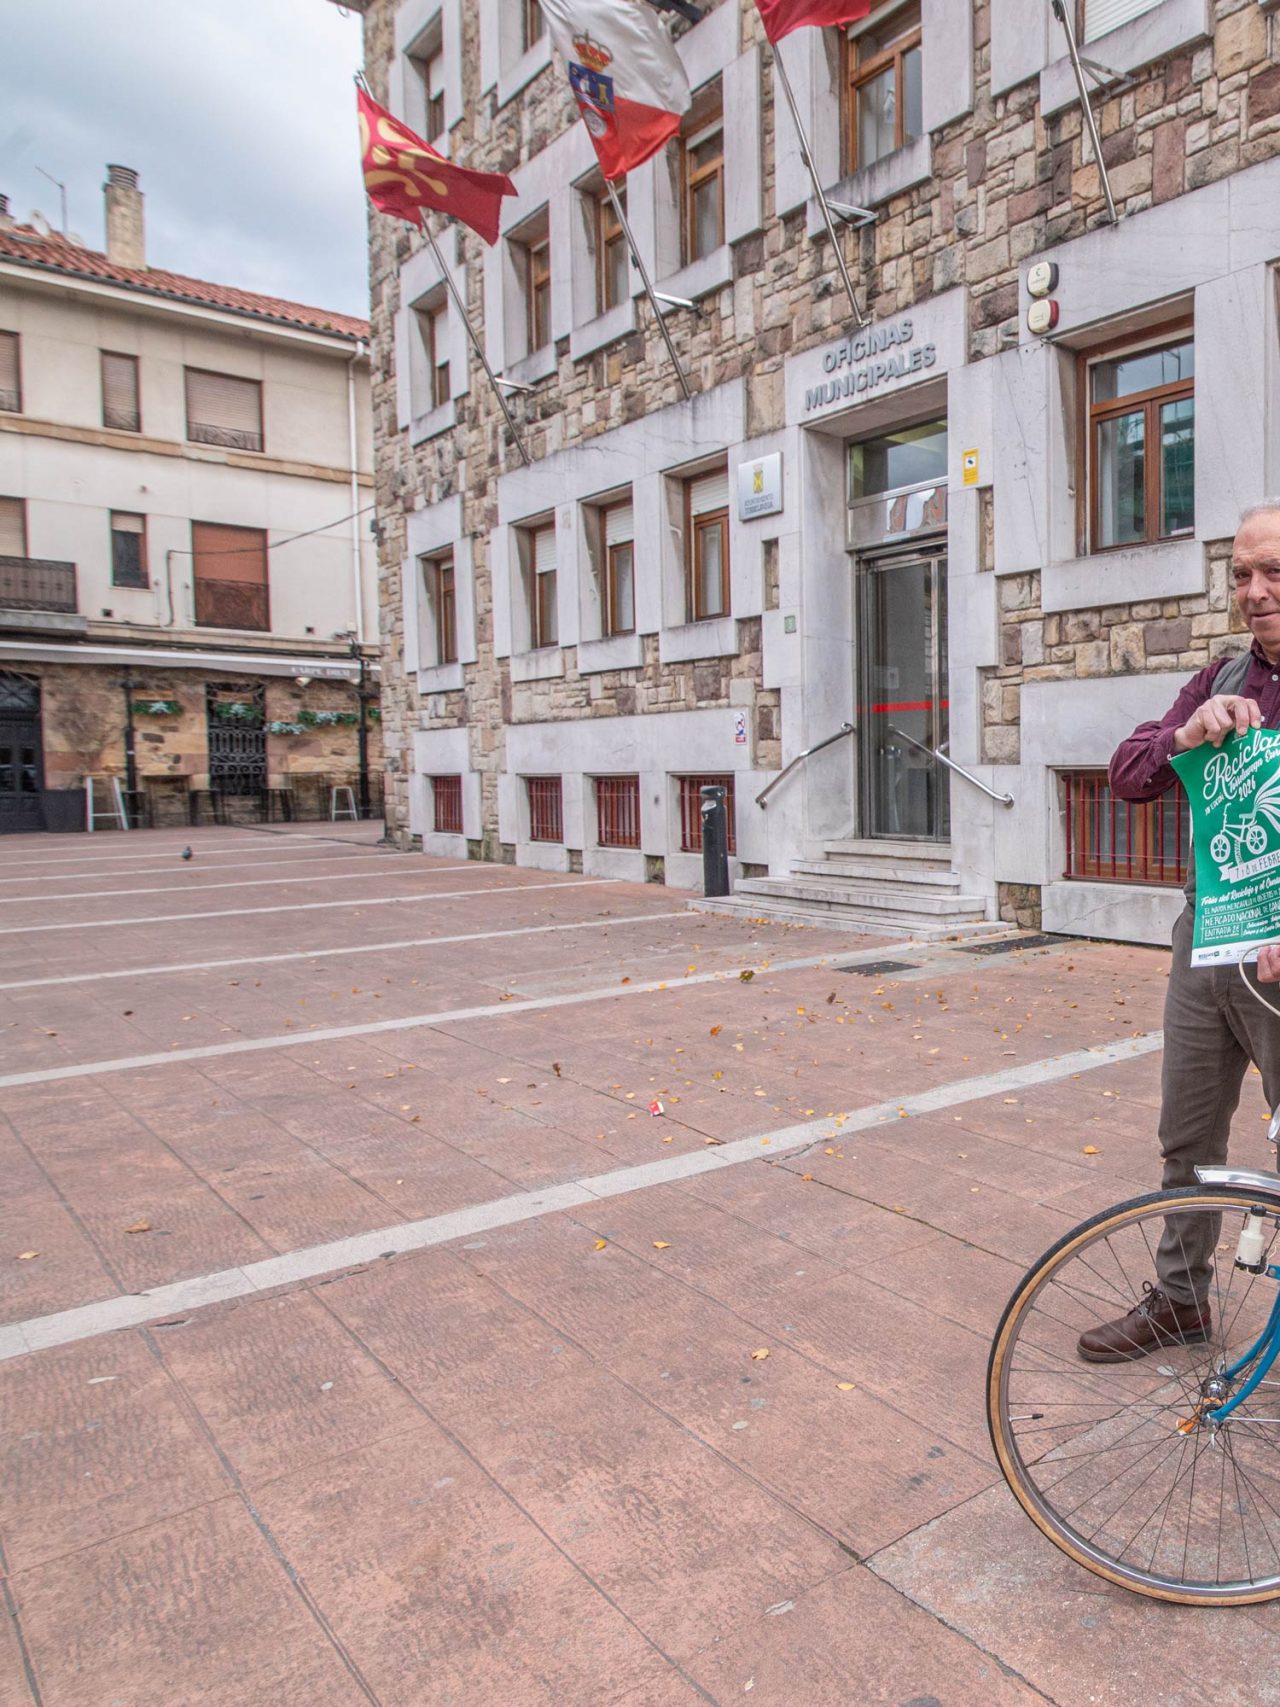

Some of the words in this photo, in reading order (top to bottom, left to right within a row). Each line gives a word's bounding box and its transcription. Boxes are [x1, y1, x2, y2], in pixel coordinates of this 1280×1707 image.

[823, 319, 913, 373] OFICINAS
[805, 342, 937, 411] MUNICIPALES
[1239, 775, 1256, 802] 2026
[1204, 914, 1236, 927] MERCADO
[1236, 906, 1263, 922] NACIONAL
[1204, 926, 1232, 938] ENTRADA
